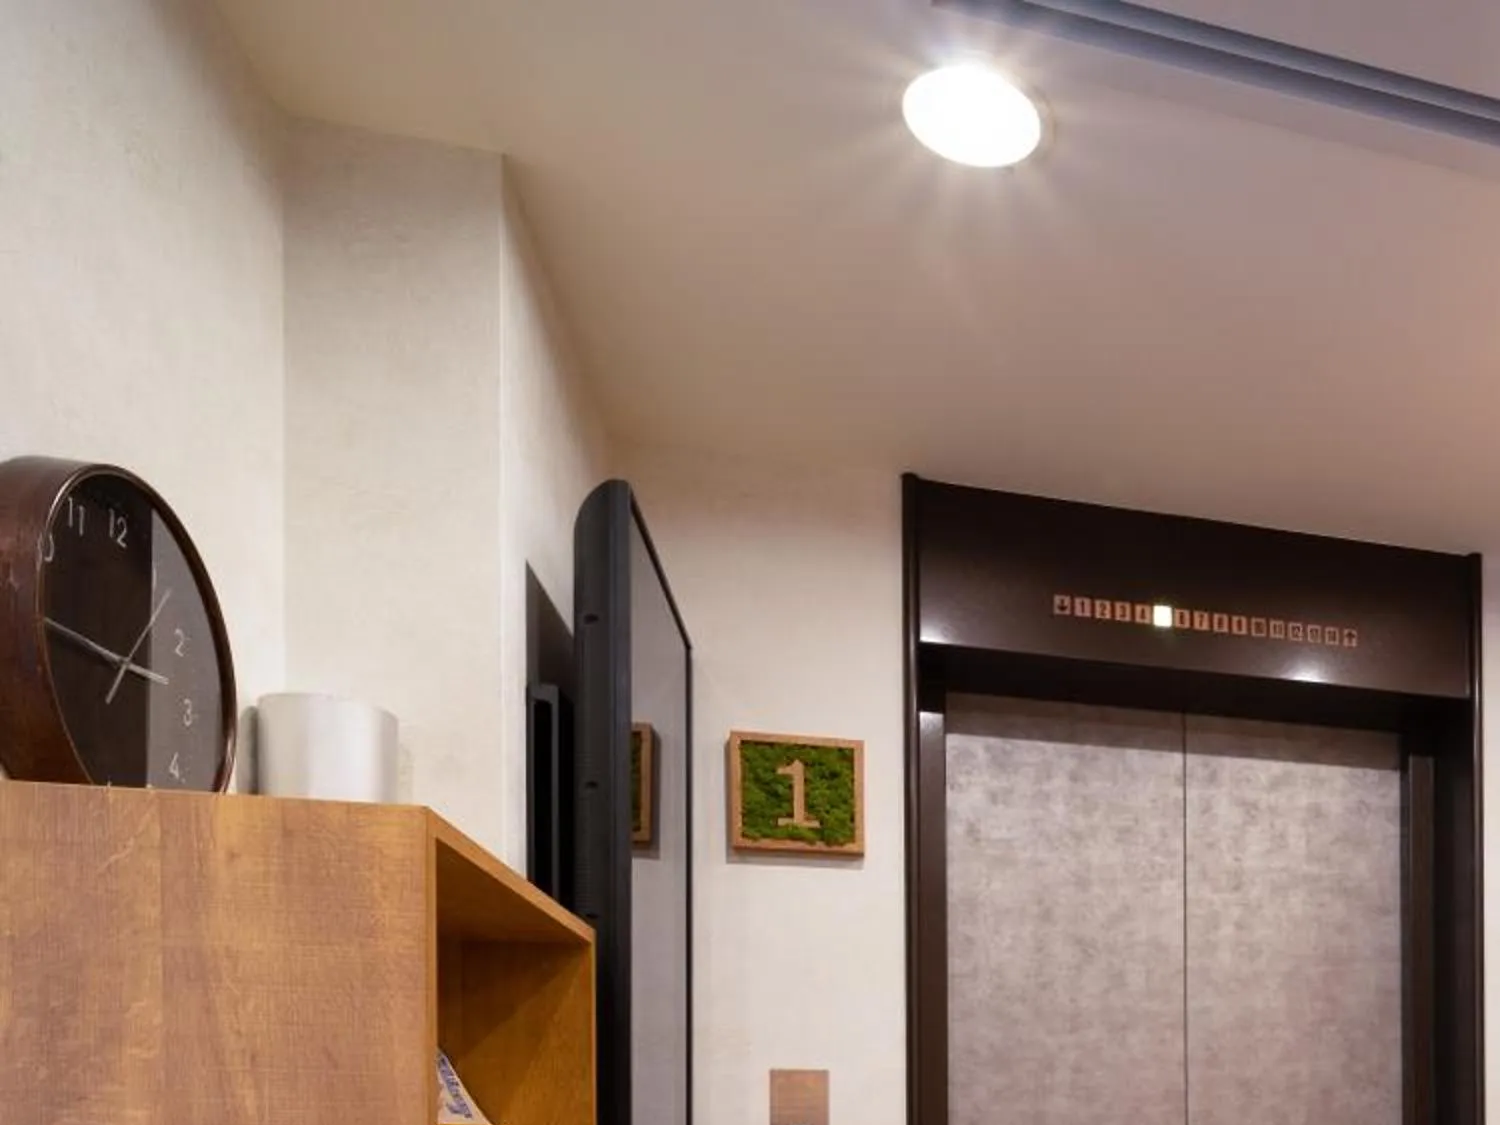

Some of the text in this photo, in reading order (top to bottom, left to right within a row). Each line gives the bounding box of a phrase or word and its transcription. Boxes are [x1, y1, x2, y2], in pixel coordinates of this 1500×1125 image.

[108, 508, 129, 549] 12
[174, 628, 185, 657] 2
[183, 699, 193, 726] 3
[168, 751, 181, 780] 4
[776, 759, 821, 828] 1
